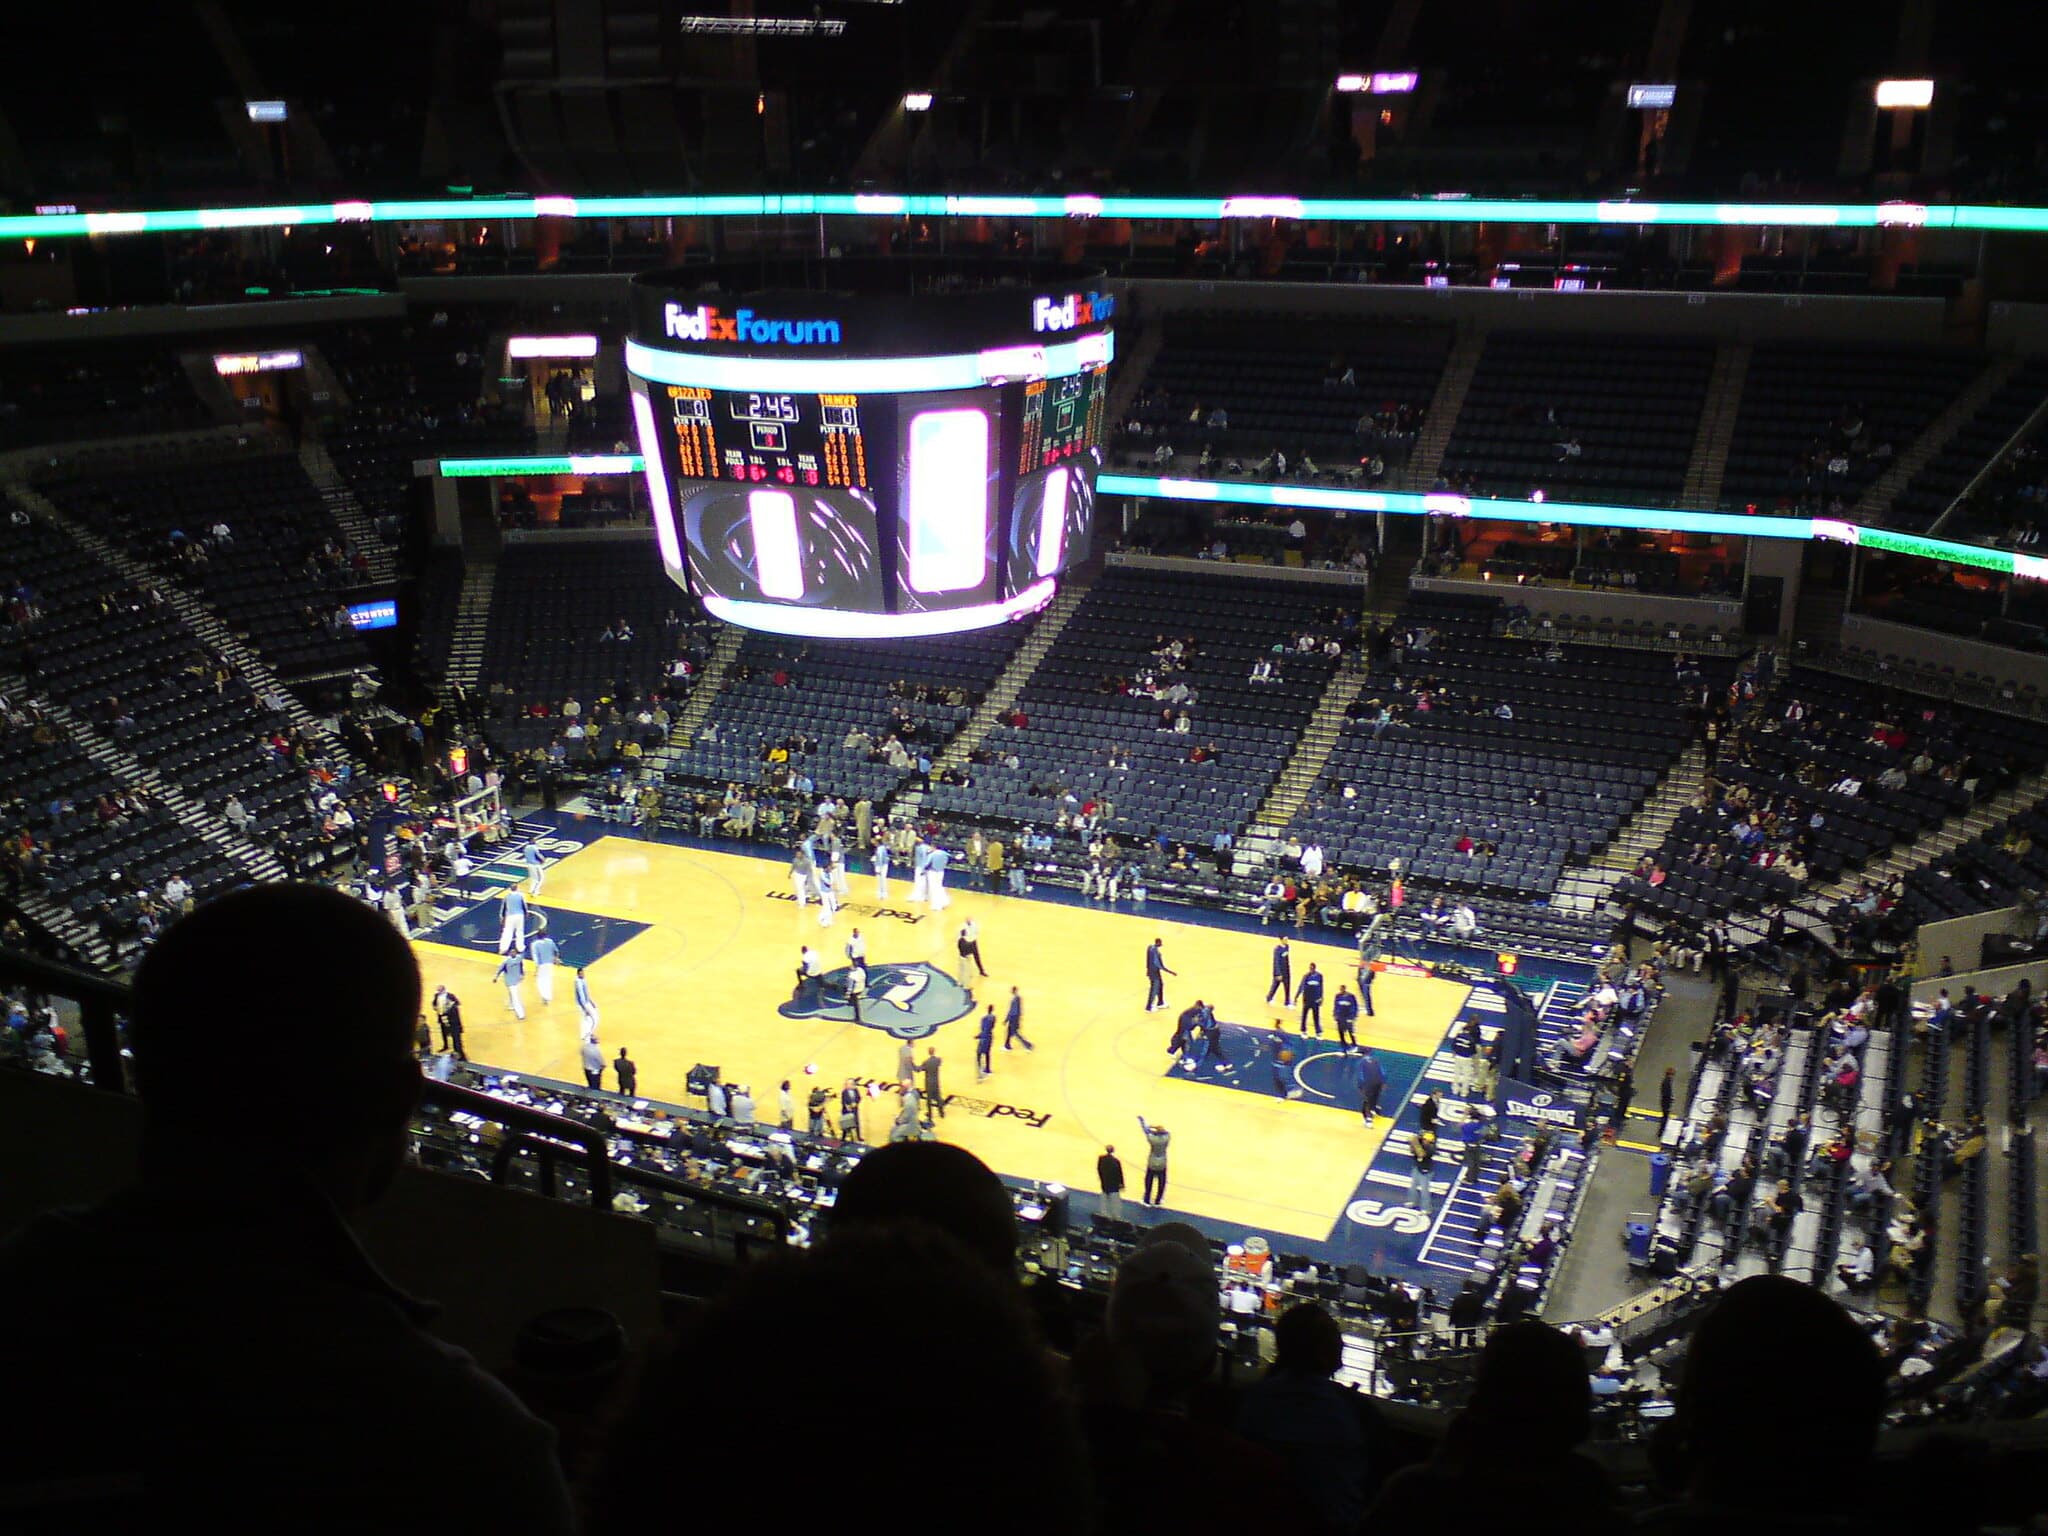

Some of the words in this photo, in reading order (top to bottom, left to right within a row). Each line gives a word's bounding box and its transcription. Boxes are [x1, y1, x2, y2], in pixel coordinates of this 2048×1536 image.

[665, 301, 841, 344] FedExForum
[819, 394, 857, 407] THUNDER
[842, 408, 852, 424] 0
[1505, 1099, 1577, 1126] SPALDING
